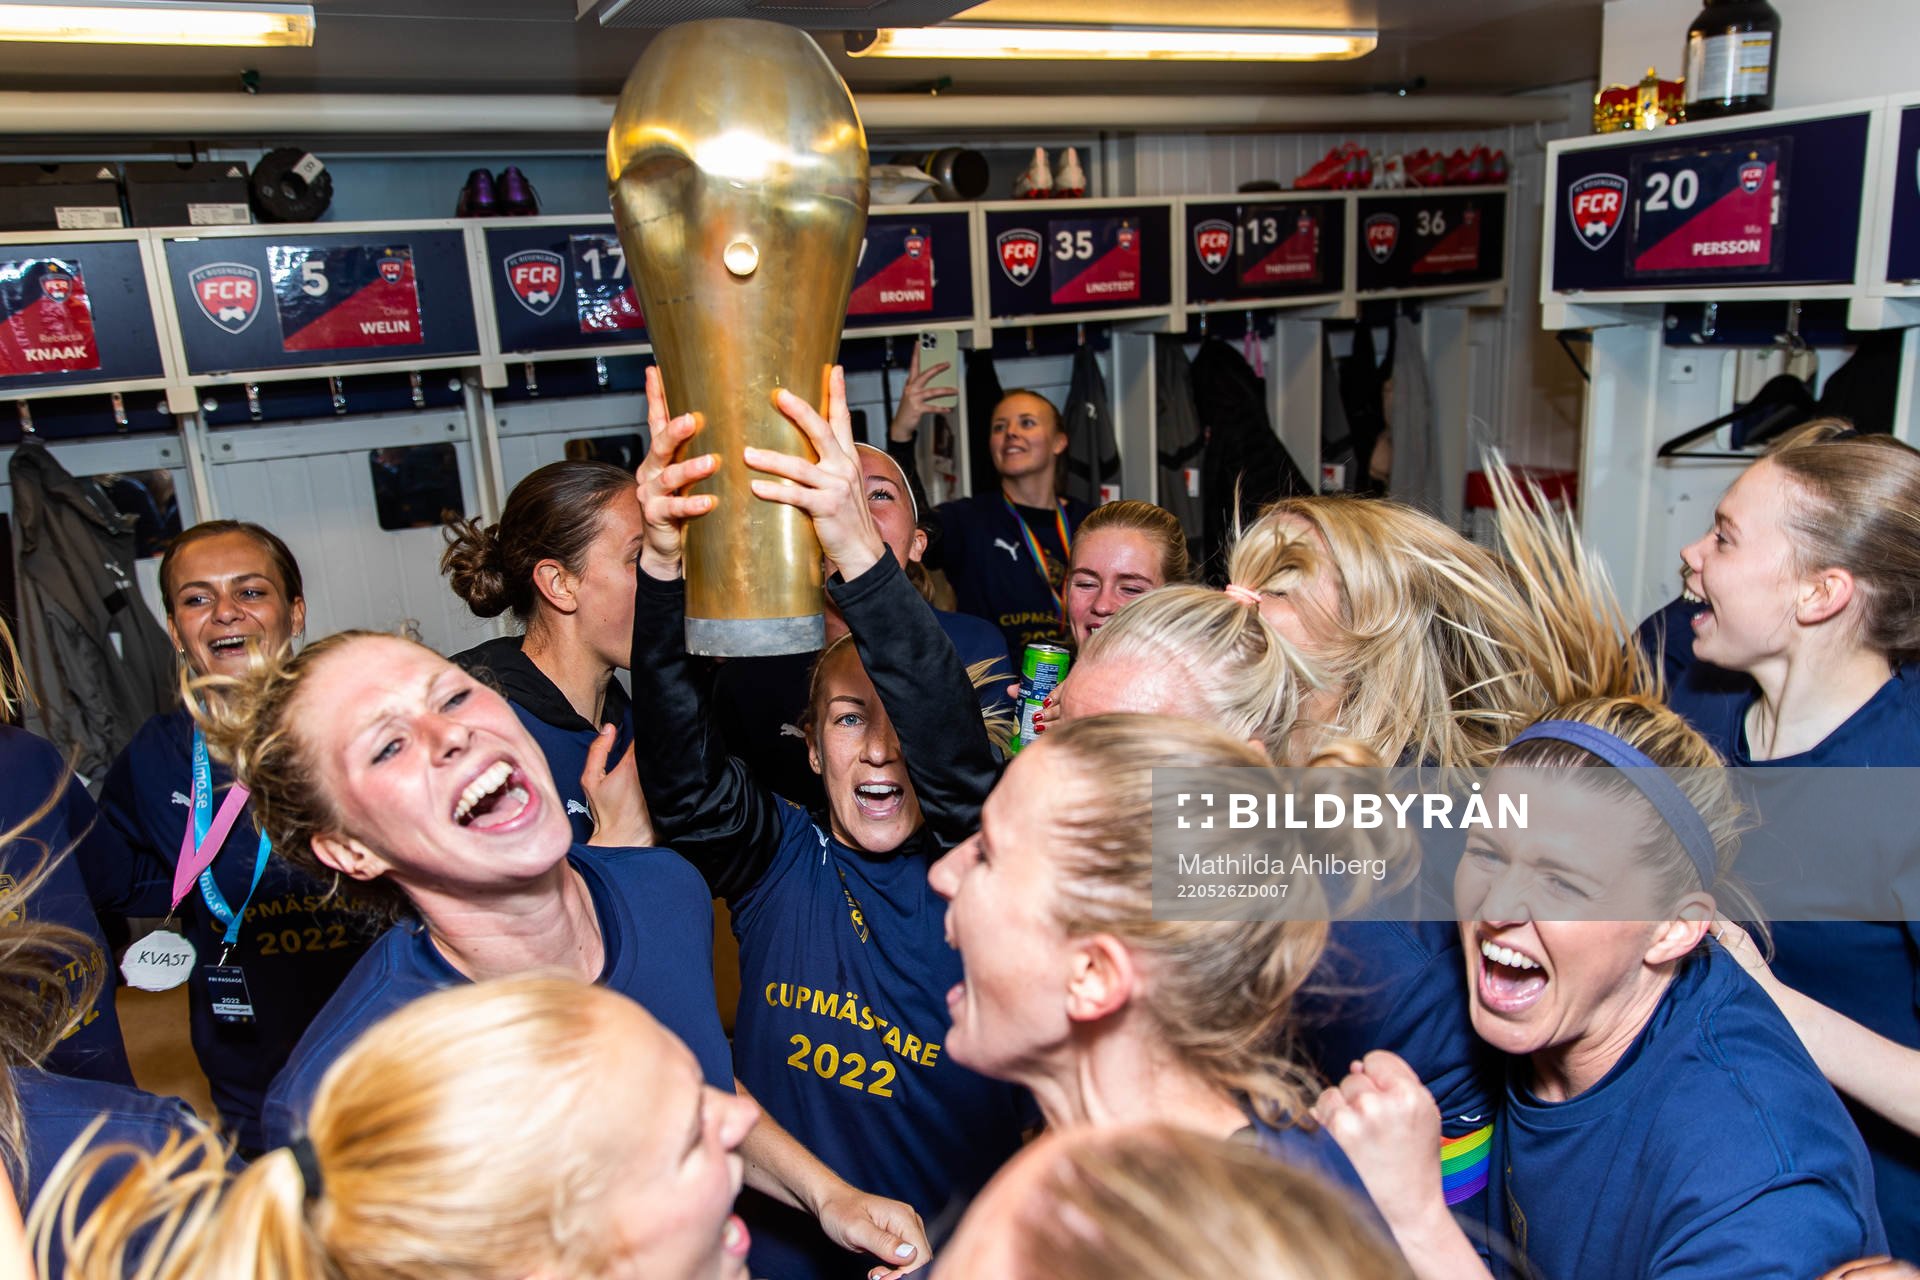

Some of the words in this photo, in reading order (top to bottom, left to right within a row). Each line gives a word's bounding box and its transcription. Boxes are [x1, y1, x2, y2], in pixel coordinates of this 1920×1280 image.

[1646, 170, 1699, 211] 20
[1576, 193, 1618, 214] FCR
[1247, 218, 1278, 243] 13
[1417, 210, 1446, 235] 36
[1004, 243, 1037, 259] FCR
[1055, 230, 1094, 260] 35
[1200, 233, 1229, 249] FCR
[1692, 239, 1761, 256] PERSSON
[582, 248, 627, 280] 17
[302, 261, 329, 297] 5
[515, 266, 557, 284] FCR
[203, 280, 253, 300] FCR
[880, 289, 925, 303] BROWN
[360, 320, 411, 335] WELIN
[24, 346, 88, 361] KNAAK
[257, 923, 348, 956] 2022
[137, 950, 191, 967] KVAST
[765, 982, 941, 1067] CUPMÄSTARE
[787, 1033, 897, 1097] 2022
